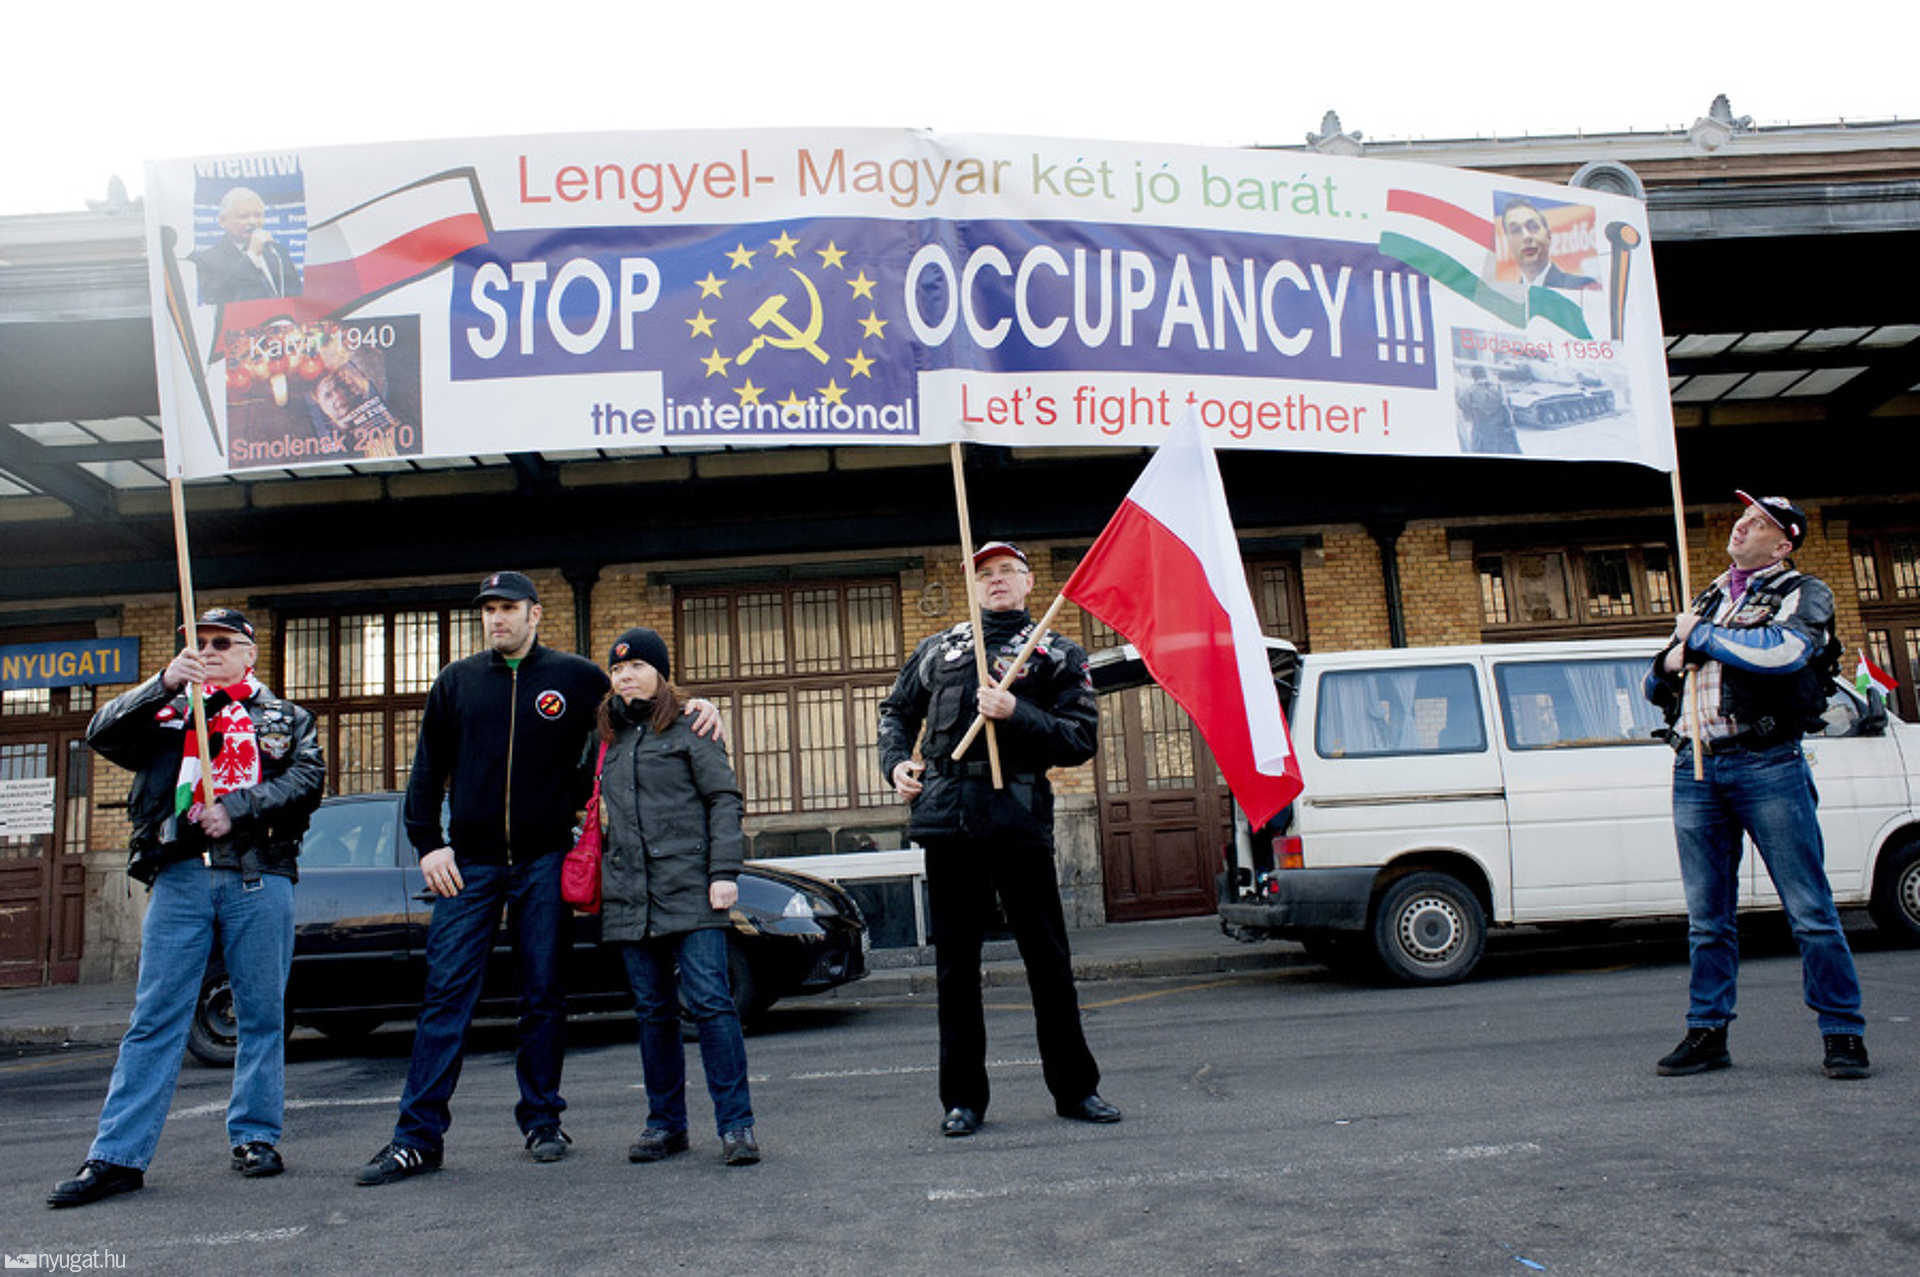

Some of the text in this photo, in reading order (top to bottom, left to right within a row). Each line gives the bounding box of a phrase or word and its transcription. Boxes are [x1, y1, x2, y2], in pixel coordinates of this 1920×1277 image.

[519, 149, 775, 213] Lengyel-
[798, 148, 1011, 208] Magyar
[1032, 153, 1115, 198] két
[1131, 160, 1181, 213] jó
[466, 257, 662, 360] STOP
[904, 244, 1351, 358] OCCUPANCY
[334, 324, 396, 352] 1940
[1461, 329, 1615, 360] Budapest 1956
[591, 398, 914, 435] the international
[1074, 386, 1170, 436] fight
[232, 425, 413, 461] Smolensk 2010
[2, 648, 120, 681] NYUGATI
